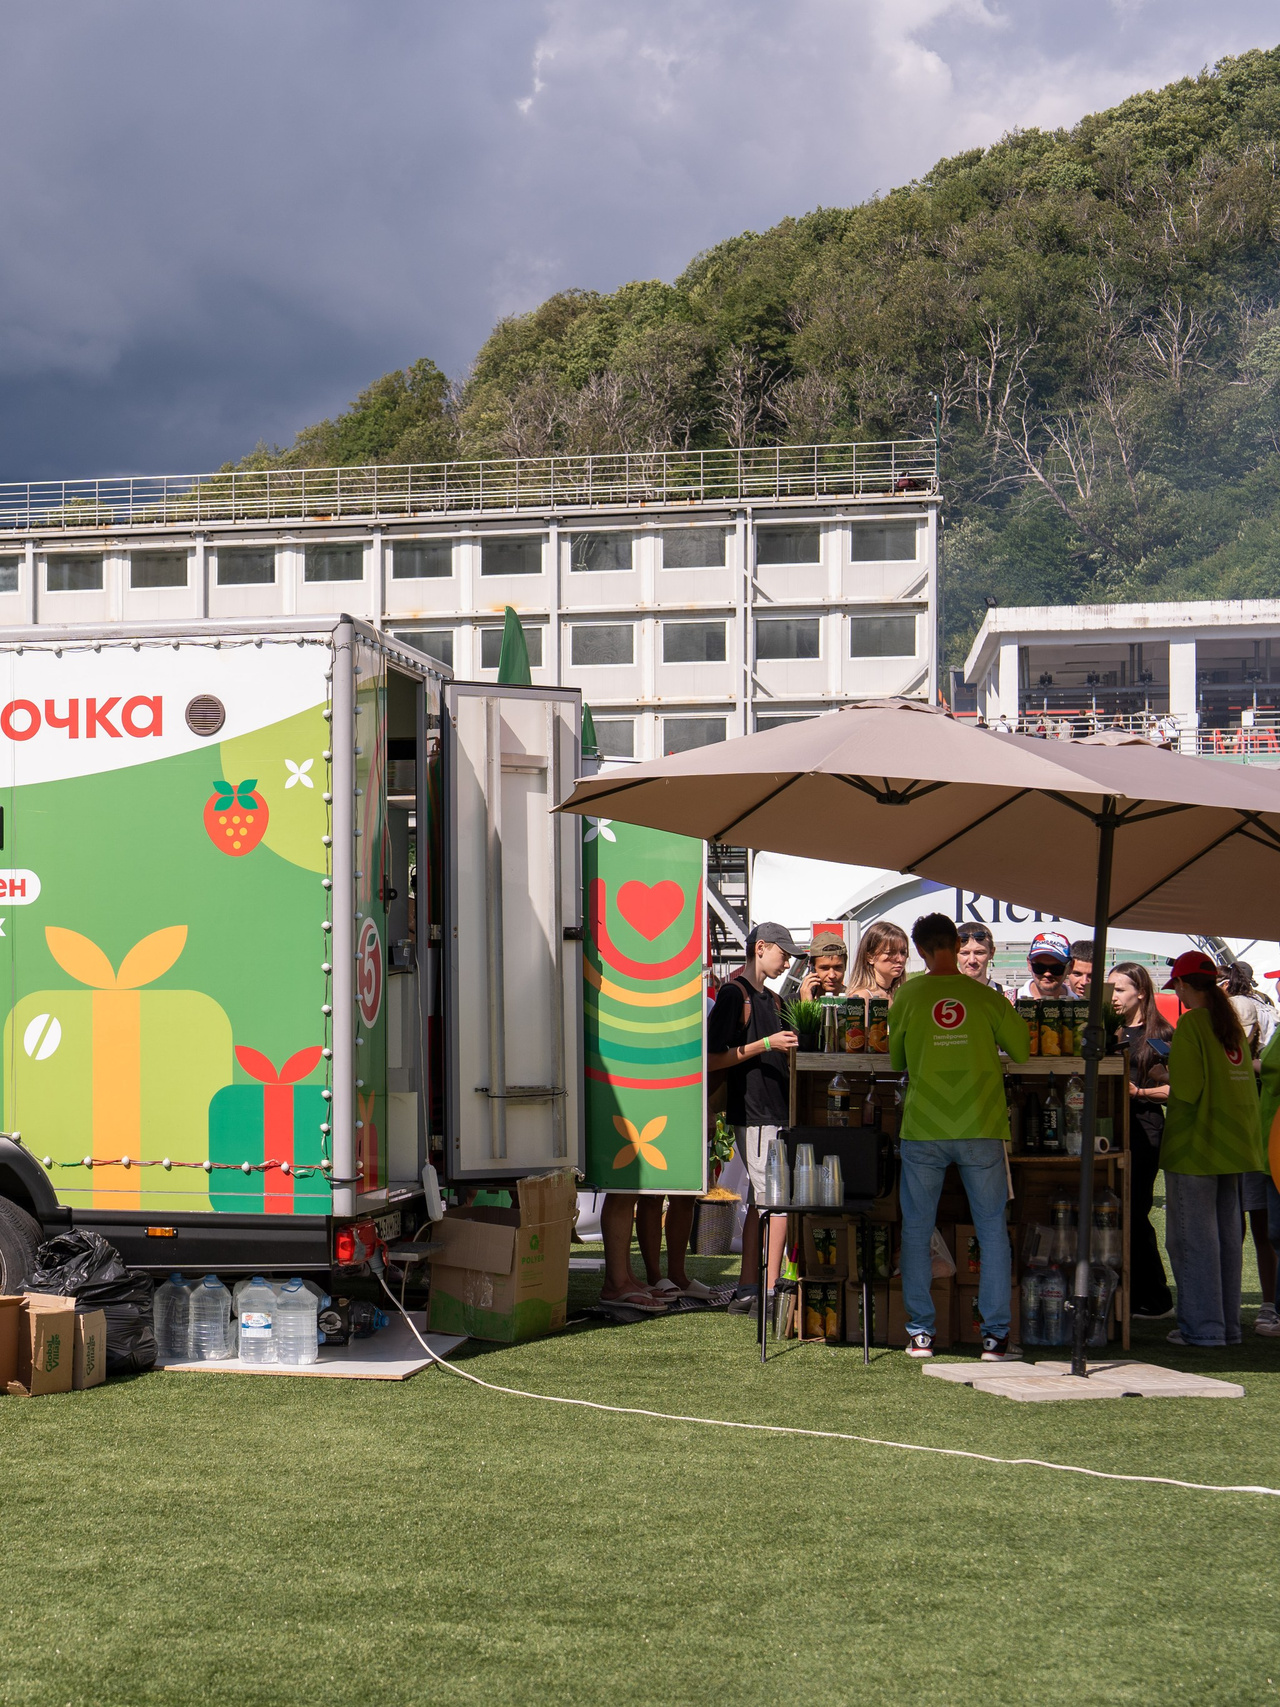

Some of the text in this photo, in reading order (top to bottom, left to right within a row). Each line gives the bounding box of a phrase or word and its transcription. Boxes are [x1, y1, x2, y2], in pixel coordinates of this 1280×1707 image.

[955, 888, 1062, 923] Ric
[46, 1335, 55, 1373] Global
[52, 1334, 61, 1369] Village
